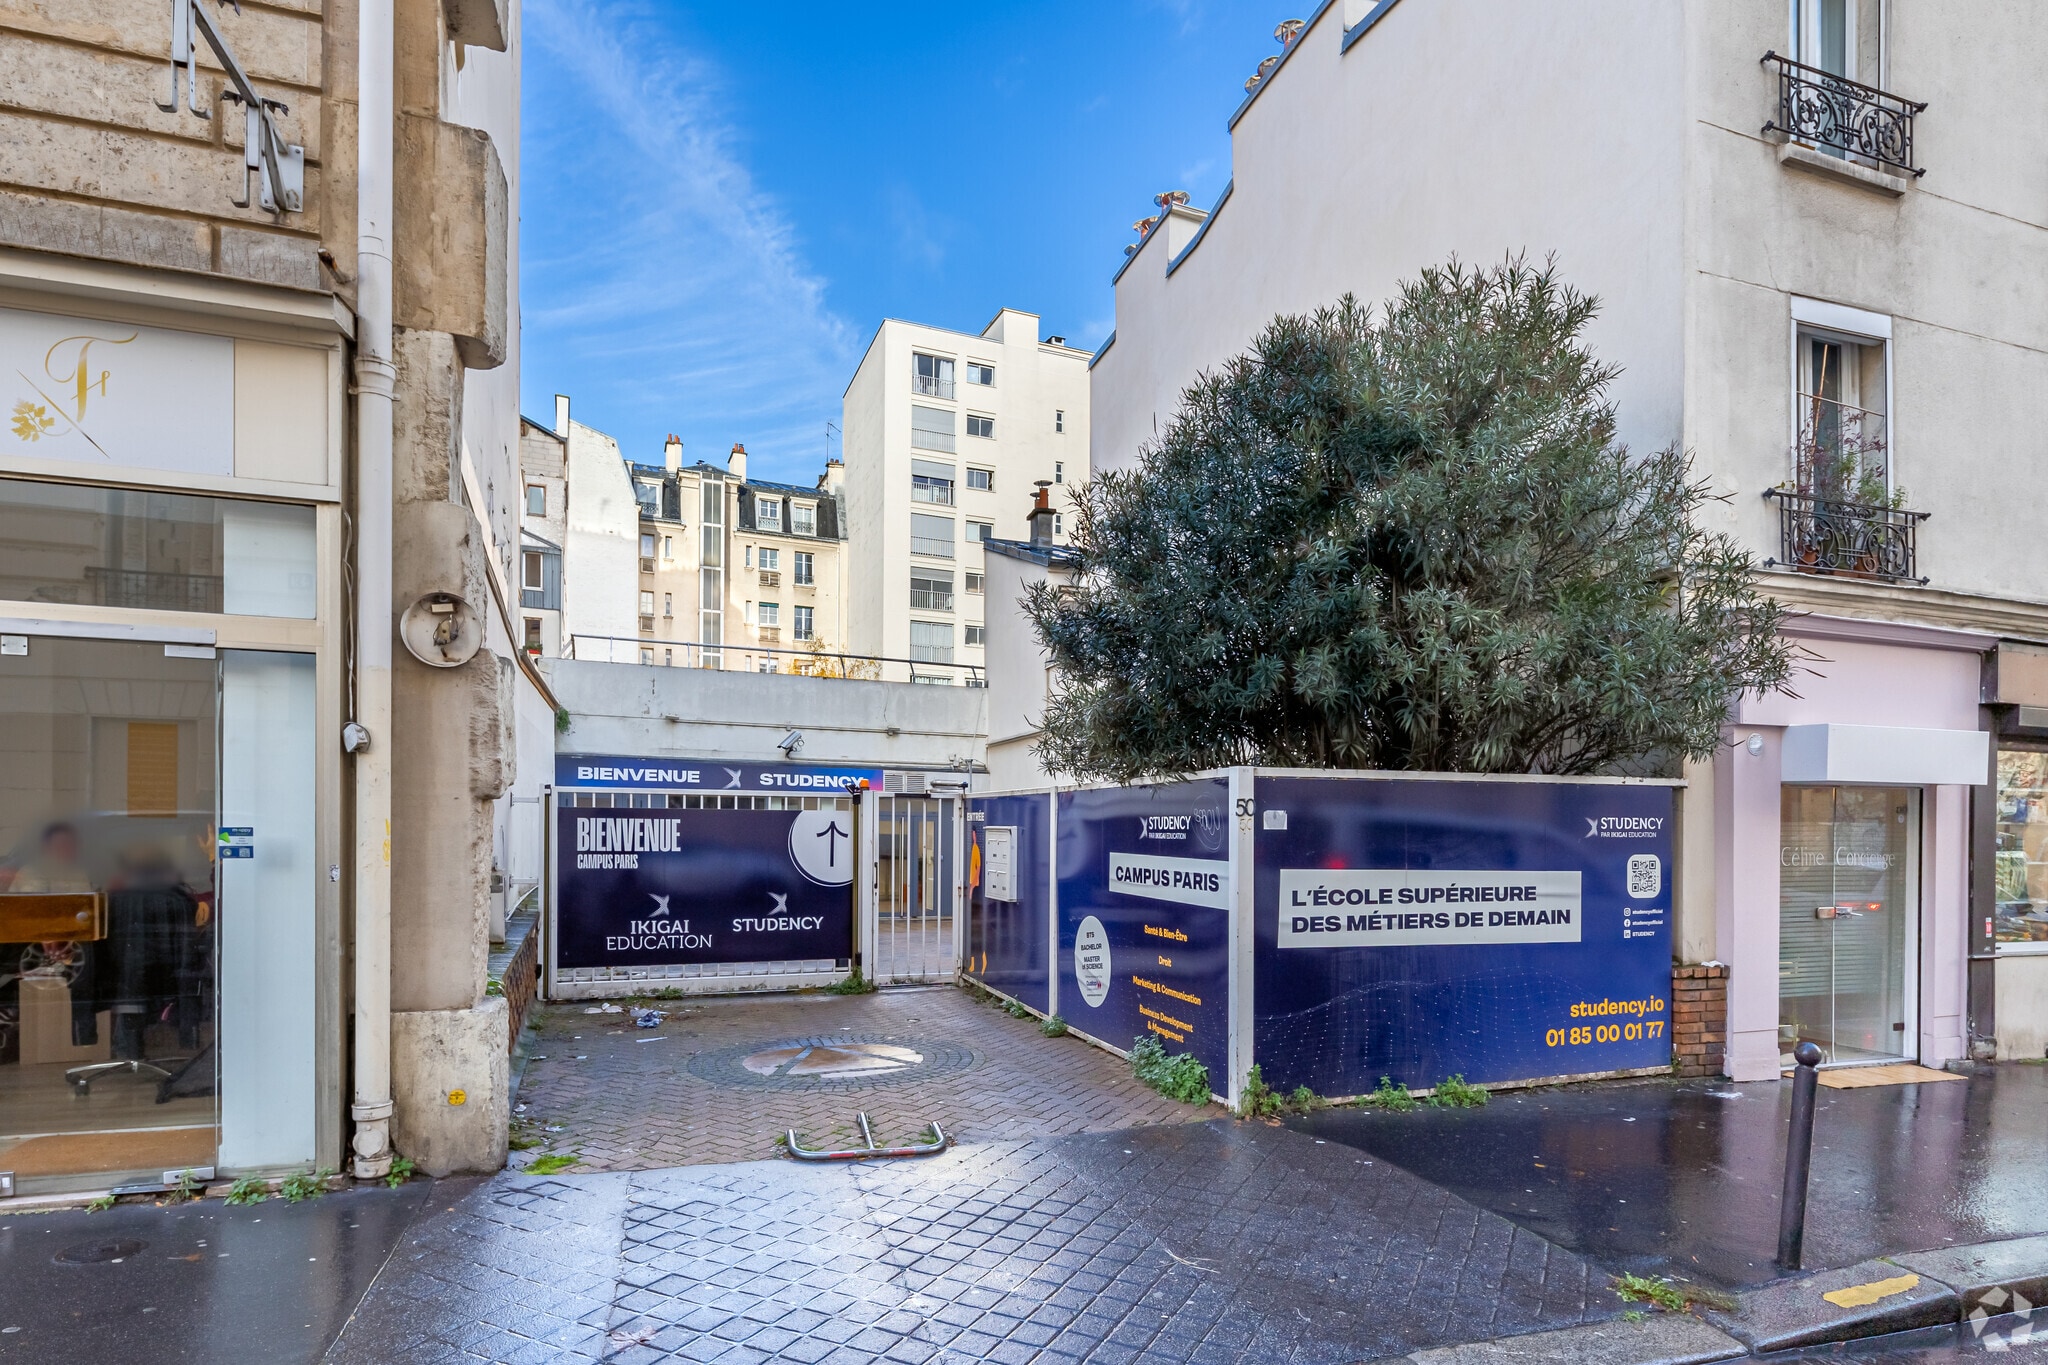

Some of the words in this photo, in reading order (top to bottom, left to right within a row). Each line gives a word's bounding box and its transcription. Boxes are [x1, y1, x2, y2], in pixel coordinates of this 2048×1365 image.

[577, 766, 700, 783] BIENVENUE
[760, 773, 864, 788] STUDENCY
[967, 810, 984, 821] ENTRÉE
[1236, 798, 1255, 817] 50
[1149, 815, 1191, 830] STUDENCY
[1600, 817, 1664, 830] STUDENCY
[577, 817, 681, 852] BIENVENUE
[577, 854, 614, 870] CAMPUS
[614, 854, 639, 870] PARIS
[1781, 846, 1825, 867] Céline
[1836, 846, 1896, 871] Concierge
[1115, 865, 1170, 887] CAMPUS
[1173, 870, 1220, 893] PARIS
[1292, 885, 1393, 907] L'ÉCOLE
[1397, 883, 1537, 905] SUPÉRIEURE
[630, 920, 689, 935] IKIGAI
[732, 916, 824, 932] STUDENCY
[1292, 915, 1342, 934] DES
[1346, 910, 1450, 932] MÉTIERS
[1455, 911, 1484, 928] DE
[1488, 909, 1571, 927] DEMAIN
[1086, 931, 1095, 939] BTS
[1144, 924, 1159, 936] Santé
[1159, 927, 1164, 937] &
[1163, 928, 1188, 942] Bien-Être
[606, 934, 713, 950] EDUCATION
[1081, 943, 1102, 951] BACHELOR
[1084, 955, 1101, 963] MASTER
[1158, 955, 1172, 968] Droit
[1132, 975, 1157, 993] Marketing
[1161, 984, 1202, 1006] Communication
[1570, 995, 1665, 1018] studency.io
[1139, 1003, 1160, 1020] Business
[1160, 1012, 1193, 1033] Development
[1147, 1020, 1152, 1030] &
[1545, 1028, 1565, 1047] 01
[1569, 1026, 1592, 1045] 85
[1596, 1024, 1621, 1043] 00
[1624, 1022, 1642, 1040] 01
[1645, 1021, 1665, 1039] 77
